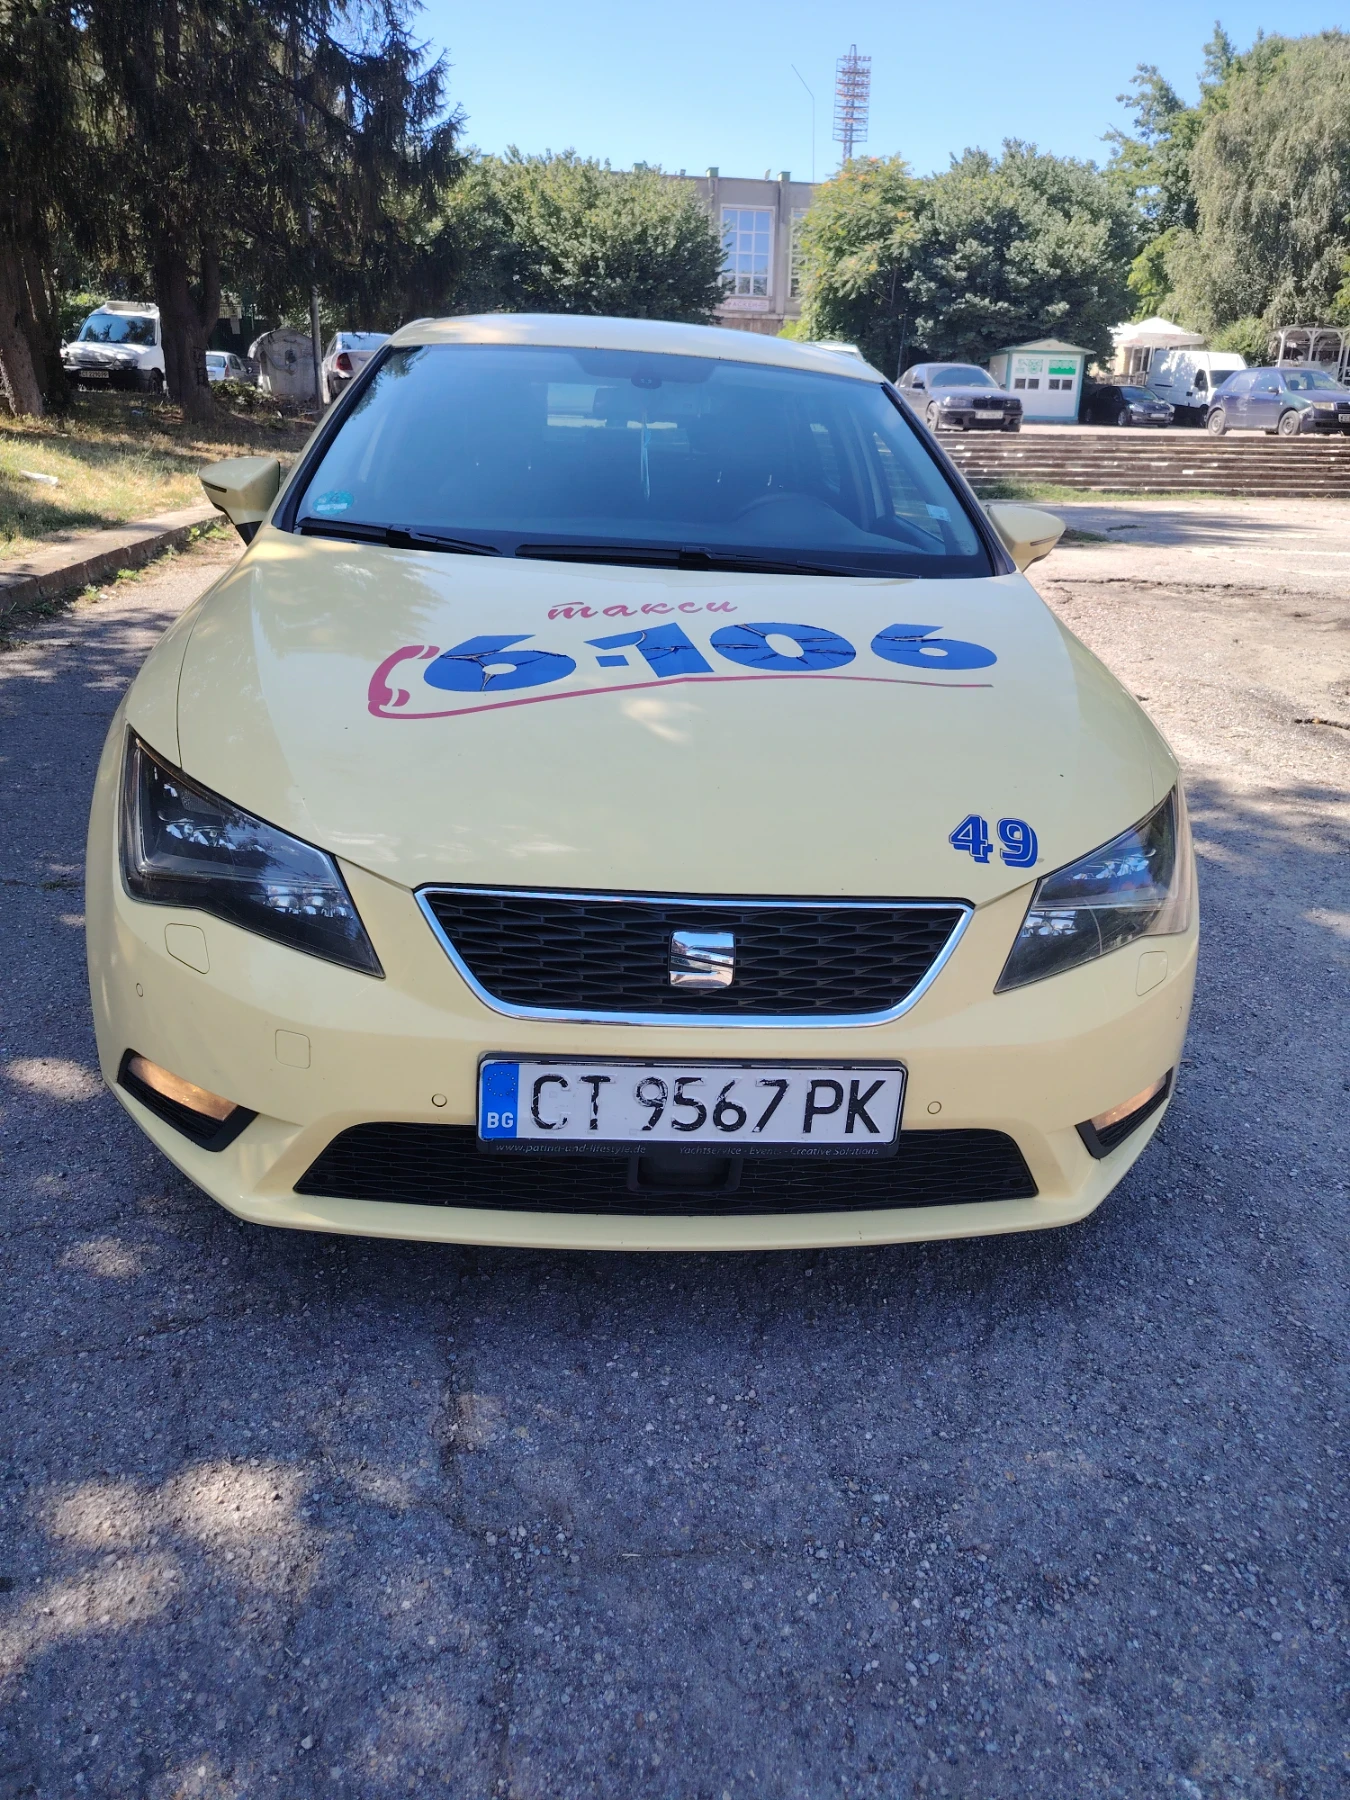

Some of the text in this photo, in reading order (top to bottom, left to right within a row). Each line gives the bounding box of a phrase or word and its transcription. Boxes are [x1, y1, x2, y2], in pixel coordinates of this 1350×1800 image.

[547, 600, 738, 620] такси
[948, 814, 1038, 868] 49
[530, 1074, 886, 1134] CT 9567 PK
[487, 1111, 514, 1128] BG
[790, 1147, 832, 1157] Creative
[834, 1147, 879, 1157] Solutions
